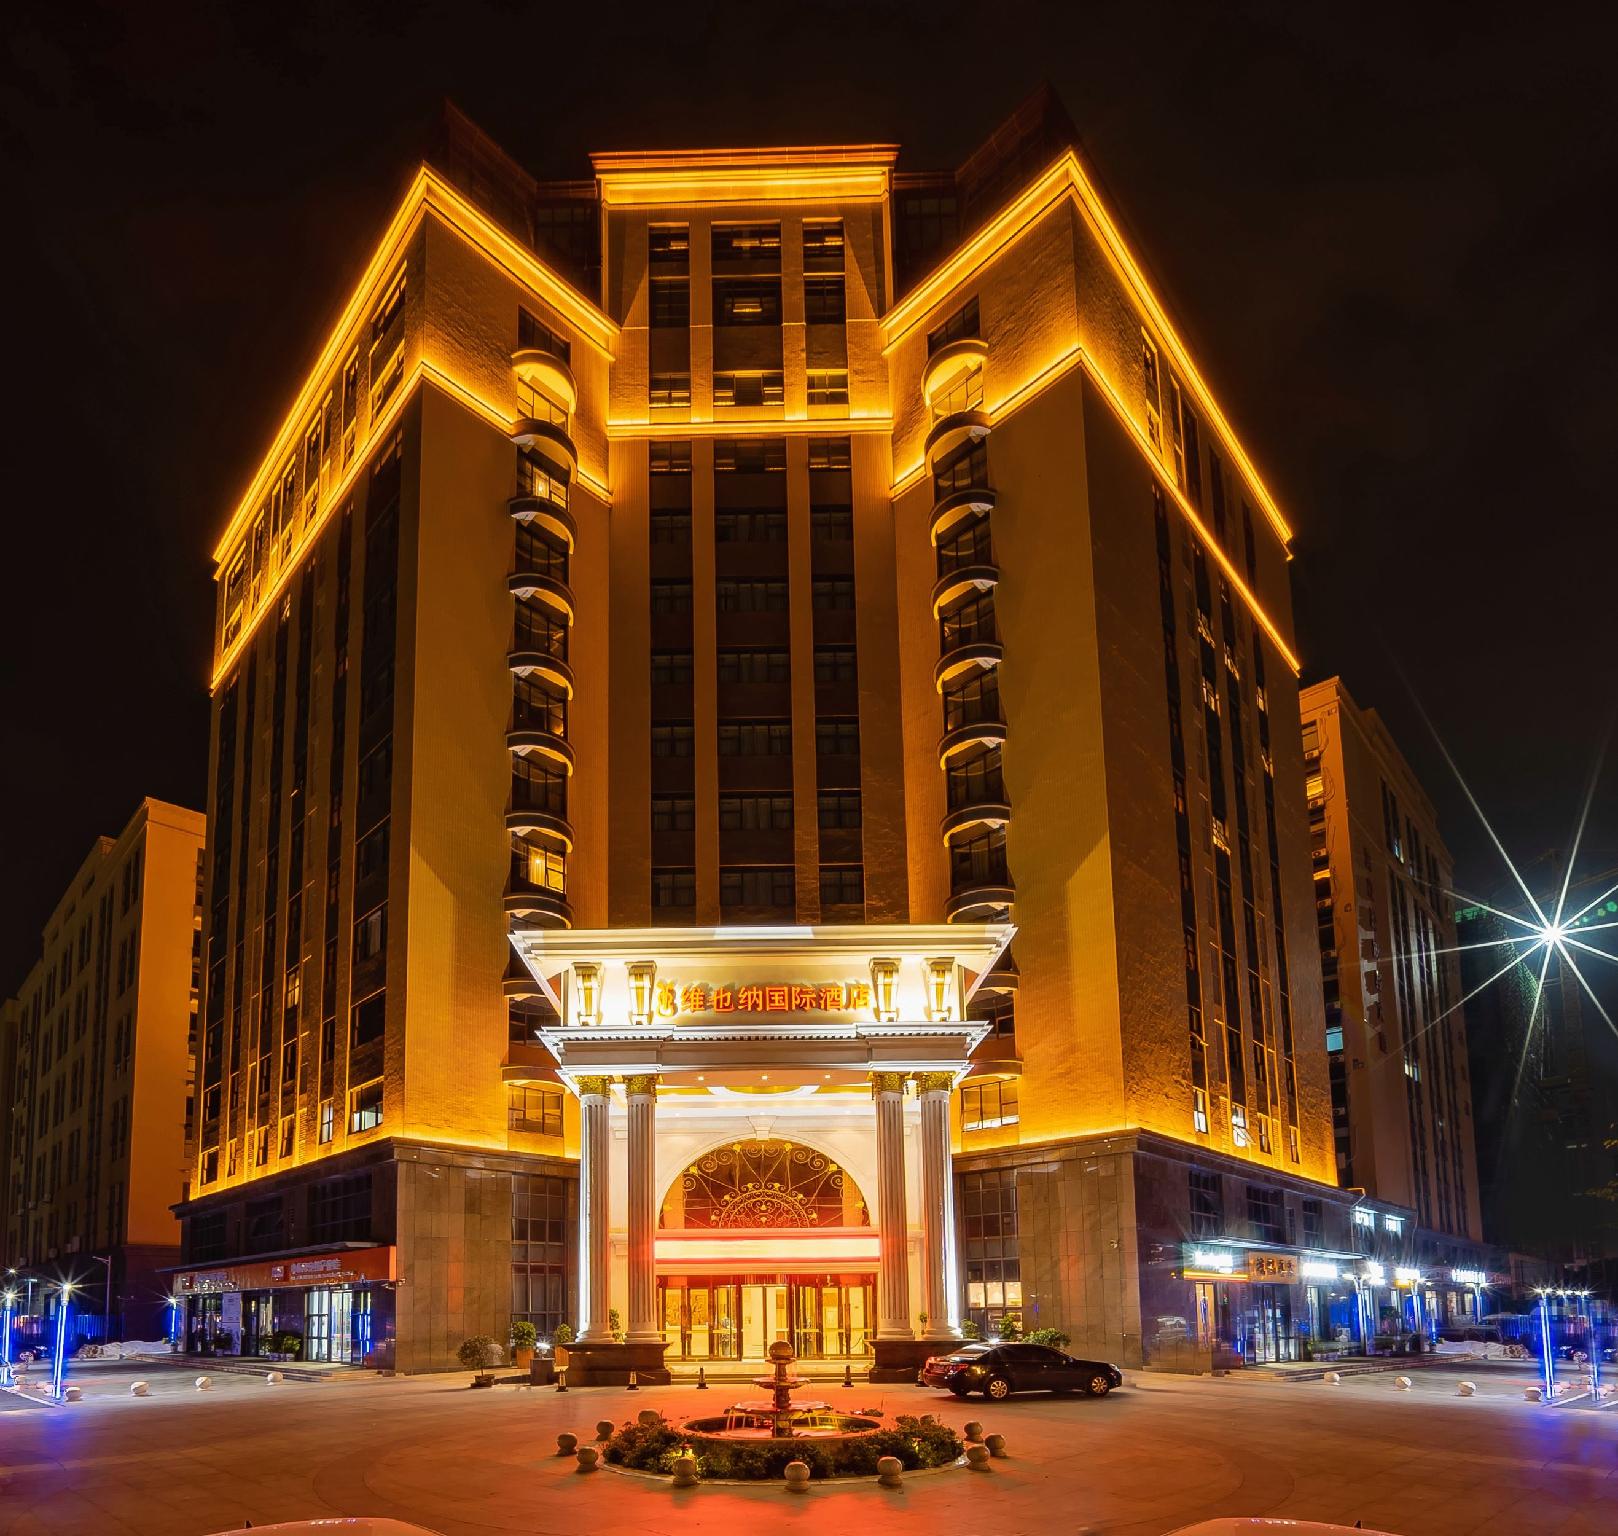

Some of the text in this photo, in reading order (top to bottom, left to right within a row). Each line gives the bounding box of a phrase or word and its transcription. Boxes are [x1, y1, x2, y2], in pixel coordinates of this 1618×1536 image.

[680, 984, 871, 1013] 维也纳国际酒店
